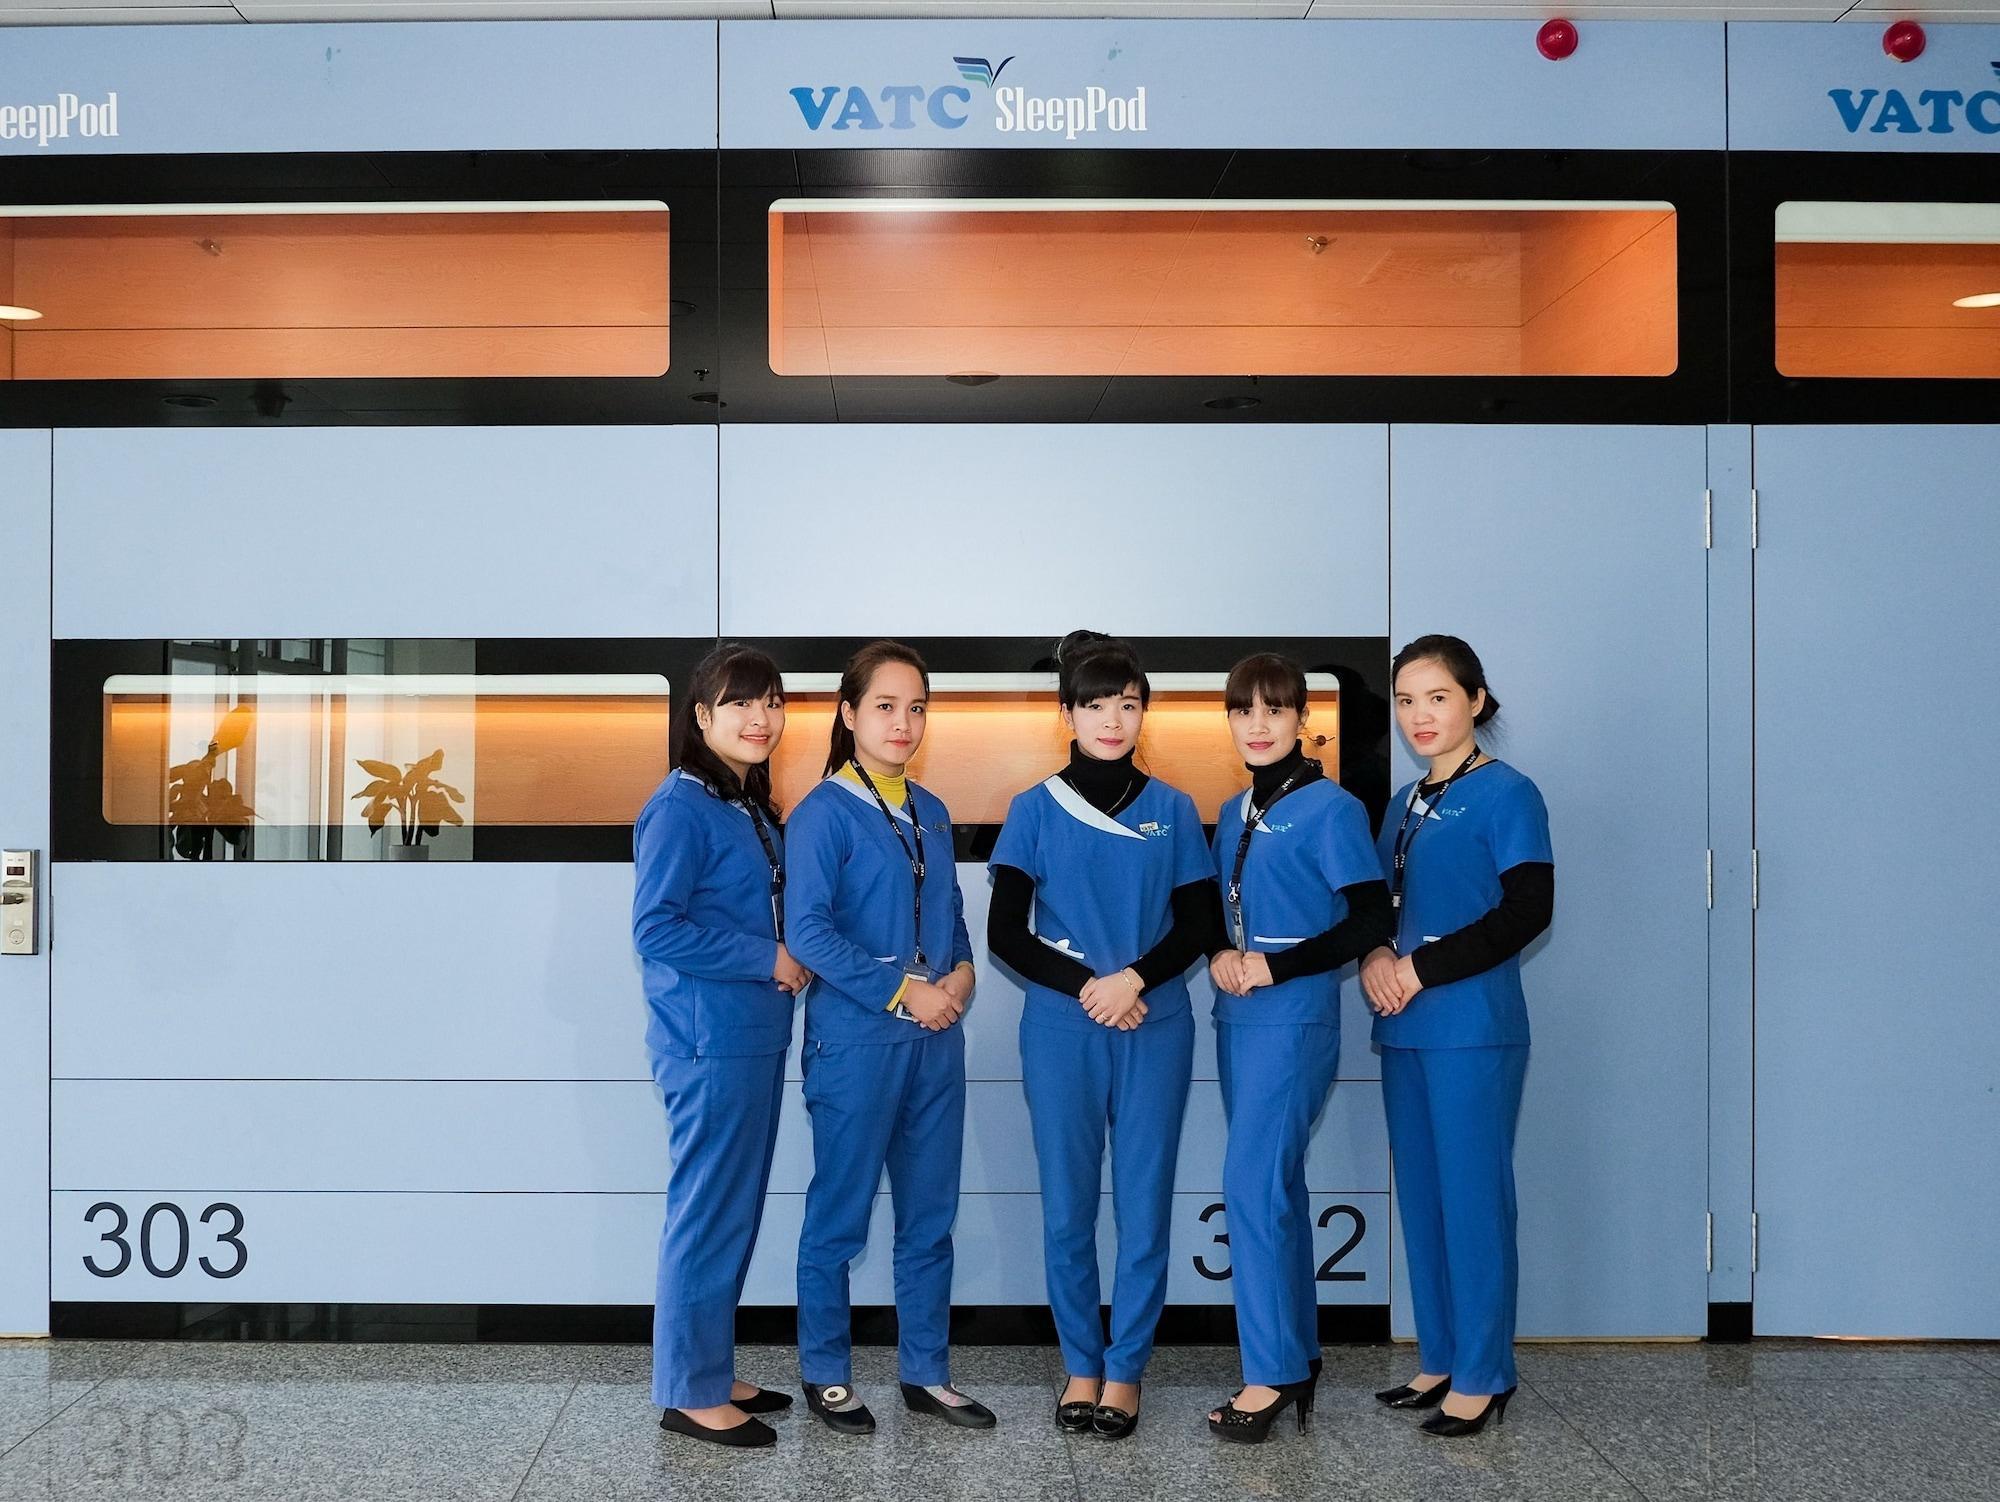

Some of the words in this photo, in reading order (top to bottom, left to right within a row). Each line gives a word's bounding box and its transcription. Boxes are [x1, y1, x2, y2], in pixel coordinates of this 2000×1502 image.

[0, 92, 119, 147] eepPod
[788, 85, 971, 131] VATC
[994, 86, 1148, 141] SleepPod
[1828, 88, 2000, 134] VATC
[82, 1202, 248, 1279] 303
[1192, 1202, 1367, 1282] 32
